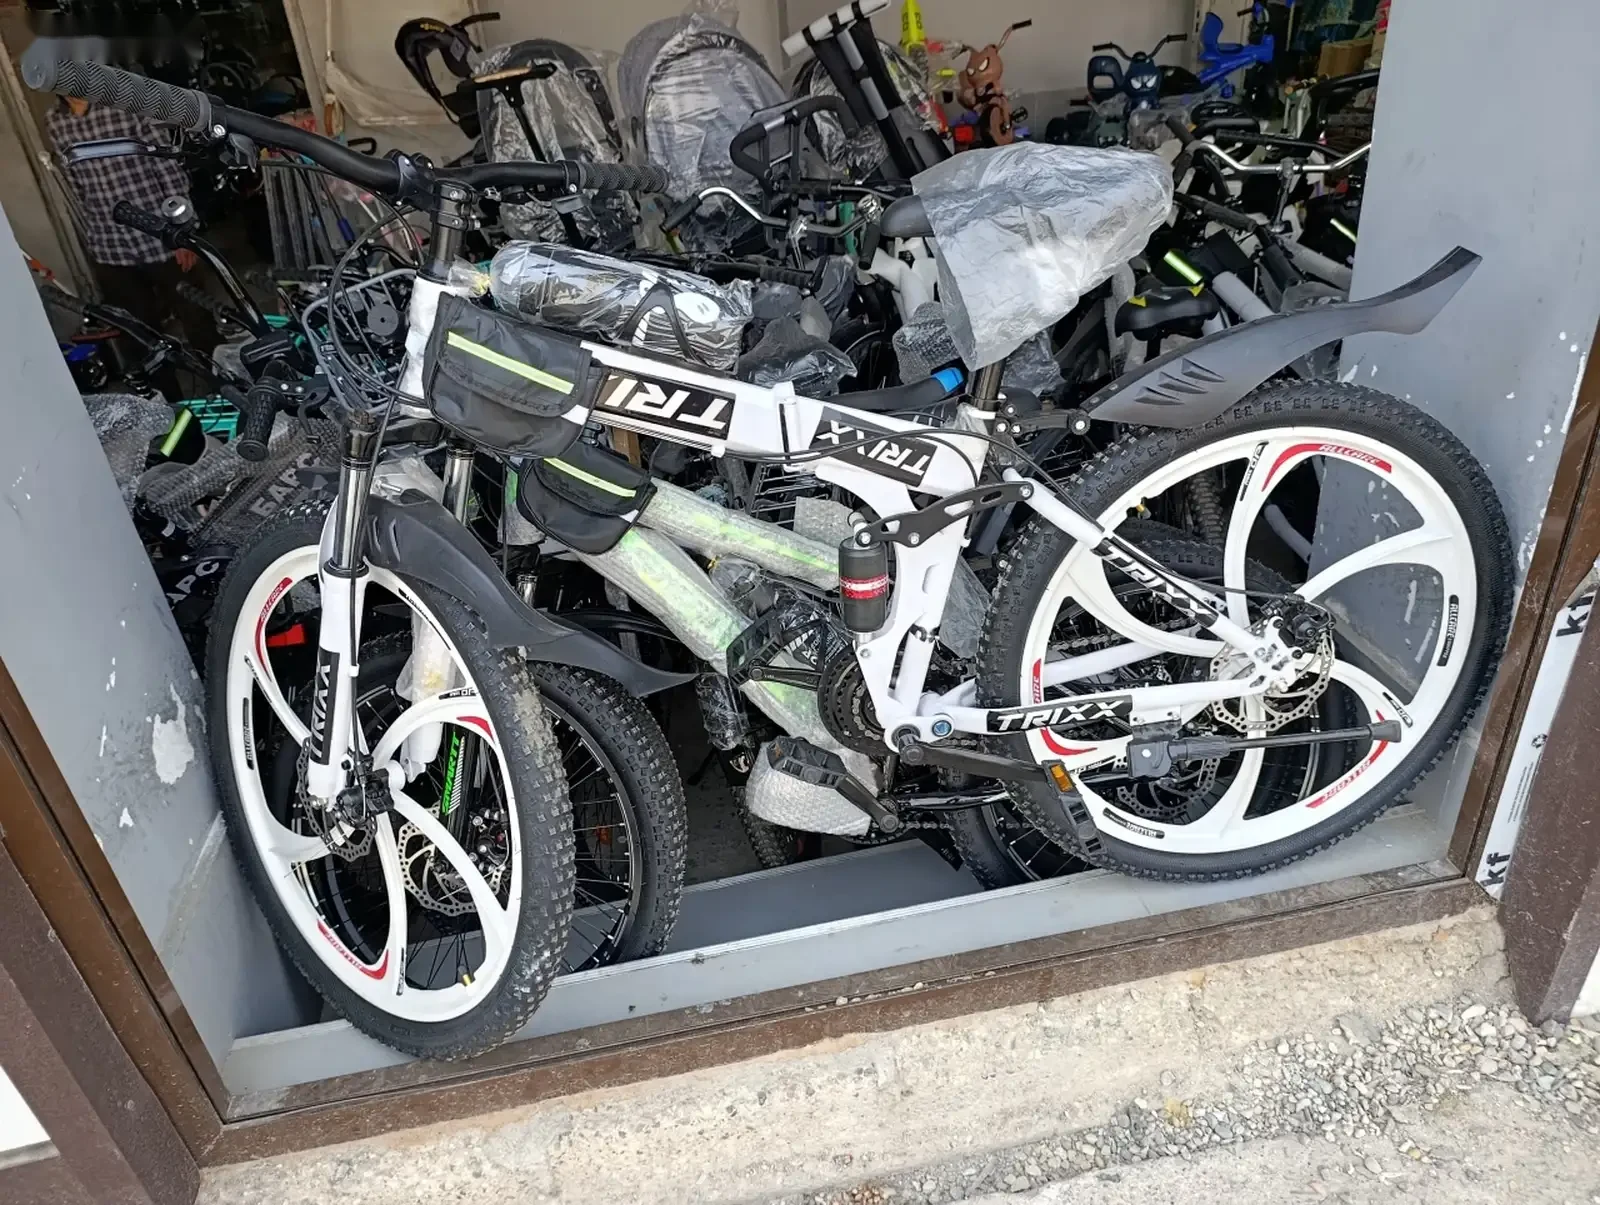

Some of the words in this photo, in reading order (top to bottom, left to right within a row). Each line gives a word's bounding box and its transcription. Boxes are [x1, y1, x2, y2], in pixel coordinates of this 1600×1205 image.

[604, 375, 729, 430] TRI
[165, 561, 220, 606] АРС
[996, 699, 1125, 732] TRIXX
[1480, 852, 1511, 887] kf
